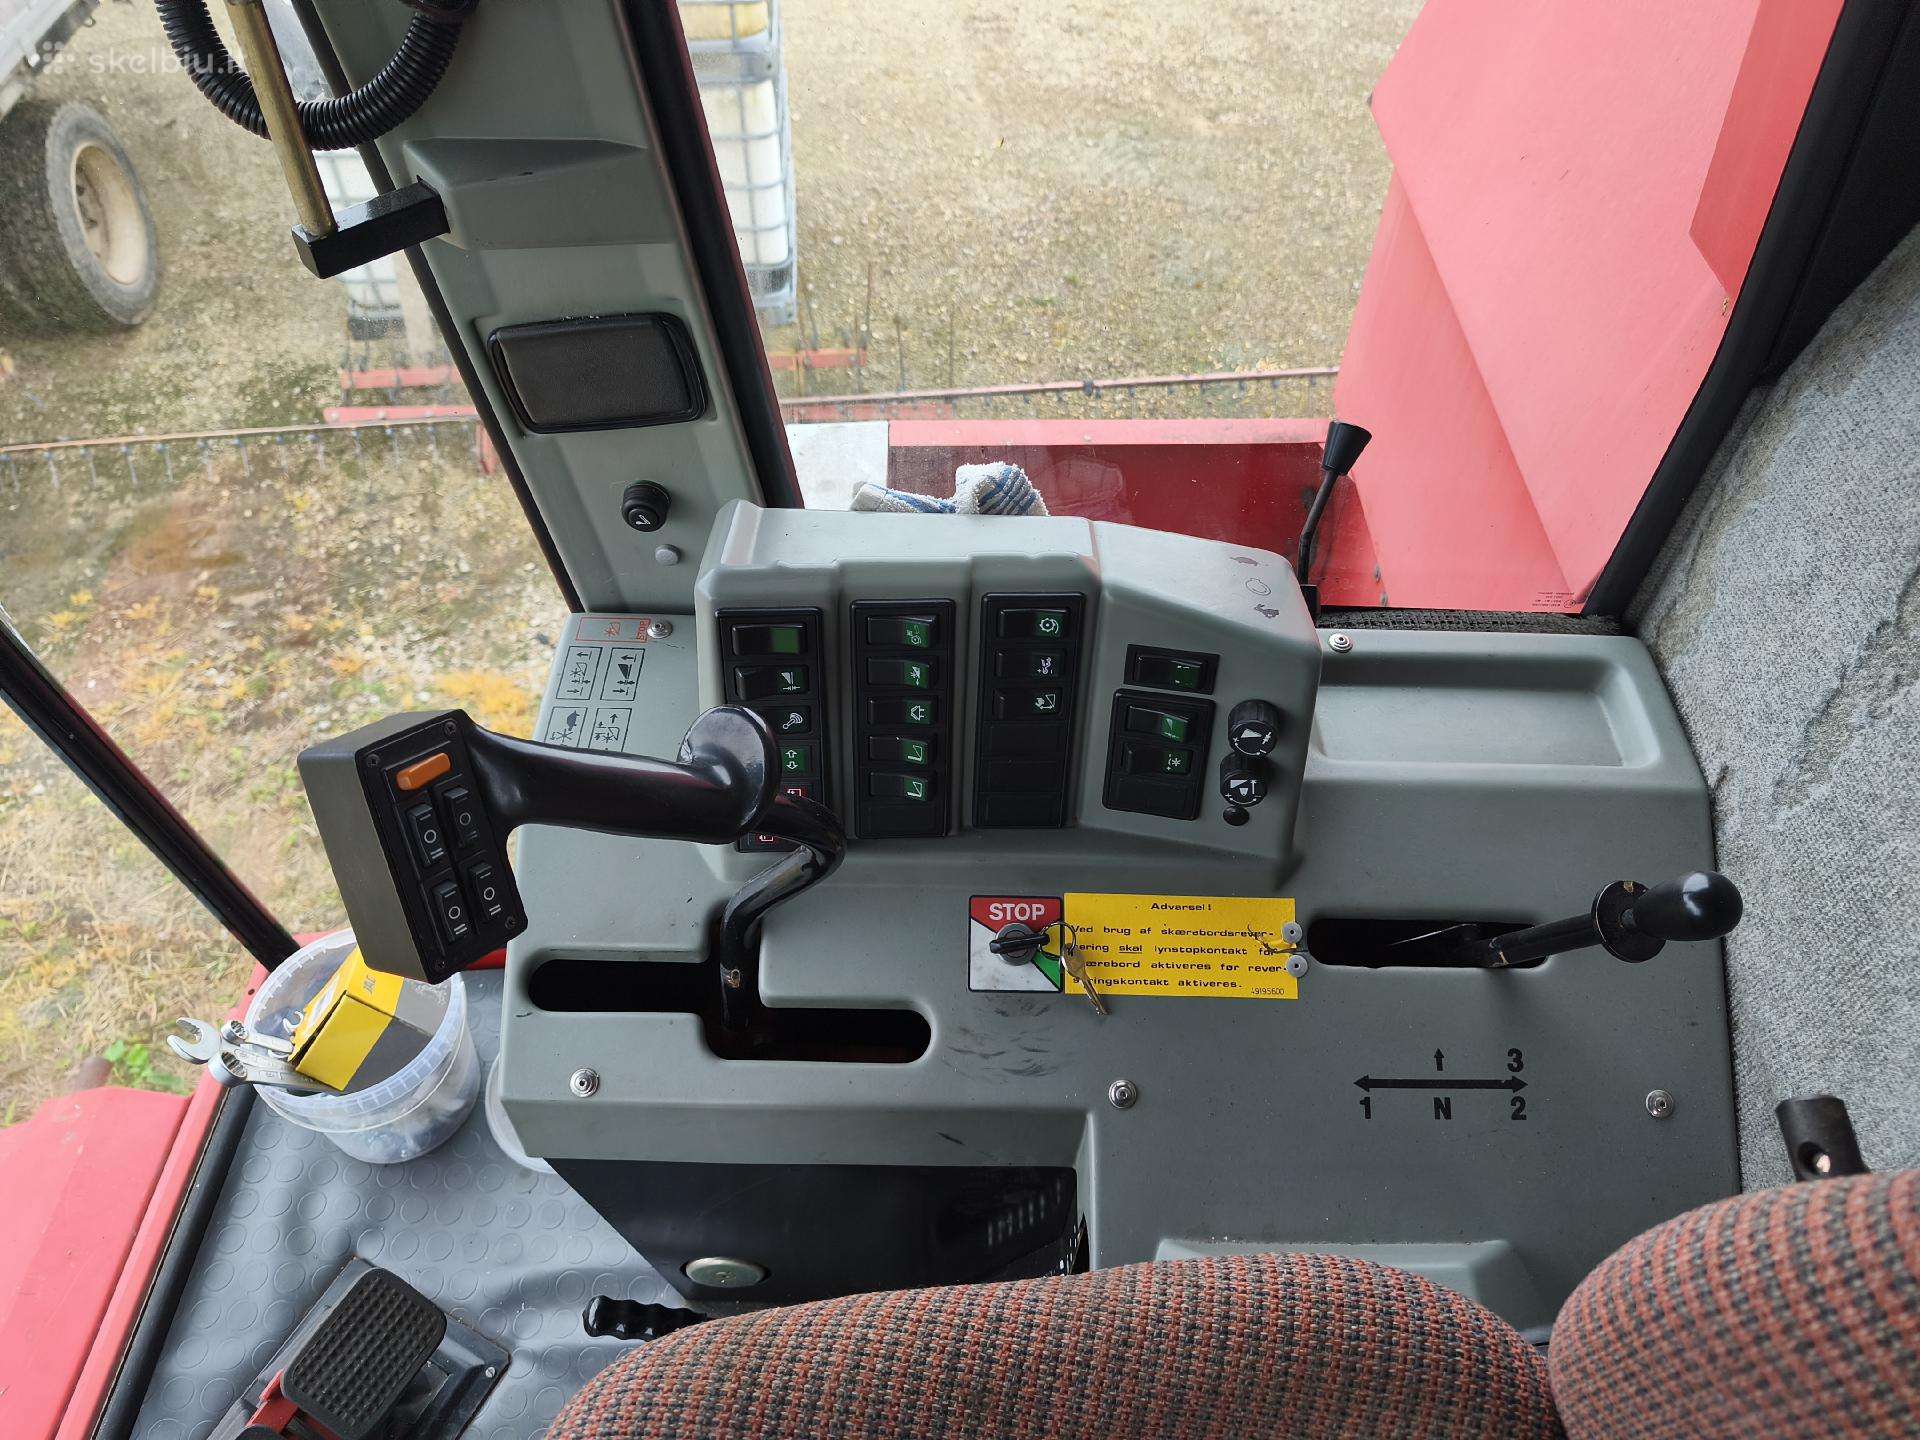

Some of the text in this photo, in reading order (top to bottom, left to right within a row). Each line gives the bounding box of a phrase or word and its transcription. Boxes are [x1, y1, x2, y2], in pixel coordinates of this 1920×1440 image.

[988, 902, 1045, 921] STOP
[1150, 902, 1212, 911] Advarsel!
[1072, 925, 1094, 933] Ved
[1103, 926, 1131, 936] brug
[1139, 927, 1152, 935] af
[1074, 943, 1109, 953] ering
[1118, 945, 1143, 953] skal
[1154, 945, 1248, 955] lynstopkontakt
[1085, 960, 1141, 969] ærebord
[1150, 961, 1211, 970] aktiveres
[1072, 977, 1243, 988] sringskontakt aktiveres.
[1507, 1047, 1525, 1073] 3
[1359, 1095, 1527, 1121] 1 N 2
